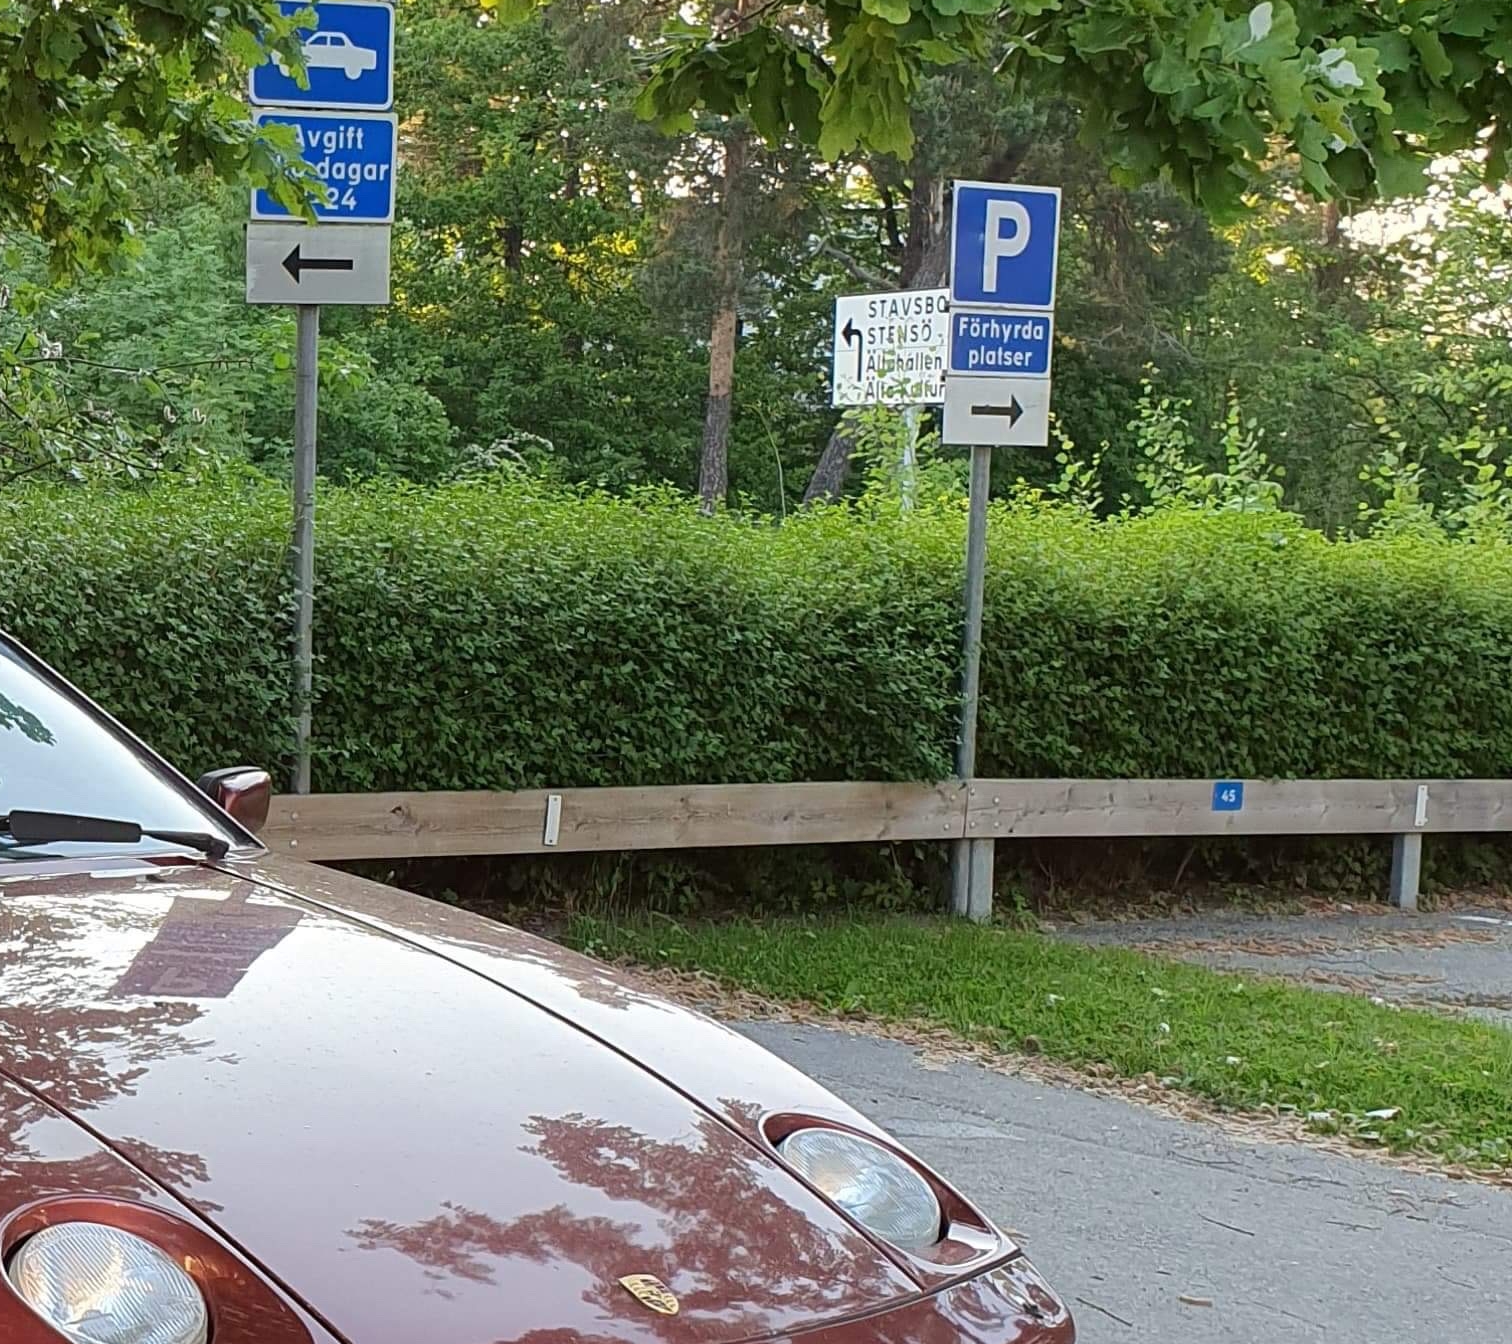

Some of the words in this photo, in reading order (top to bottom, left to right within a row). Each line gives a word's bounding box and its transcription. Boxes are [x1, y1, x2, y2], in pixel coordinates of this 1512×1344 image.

[982, 198, 1031, 294] P
[958, 316, 1044, 344] Förhyrda
[968, 345, 1033, 369] platser
[1220, 788, 1236, 803] 45
